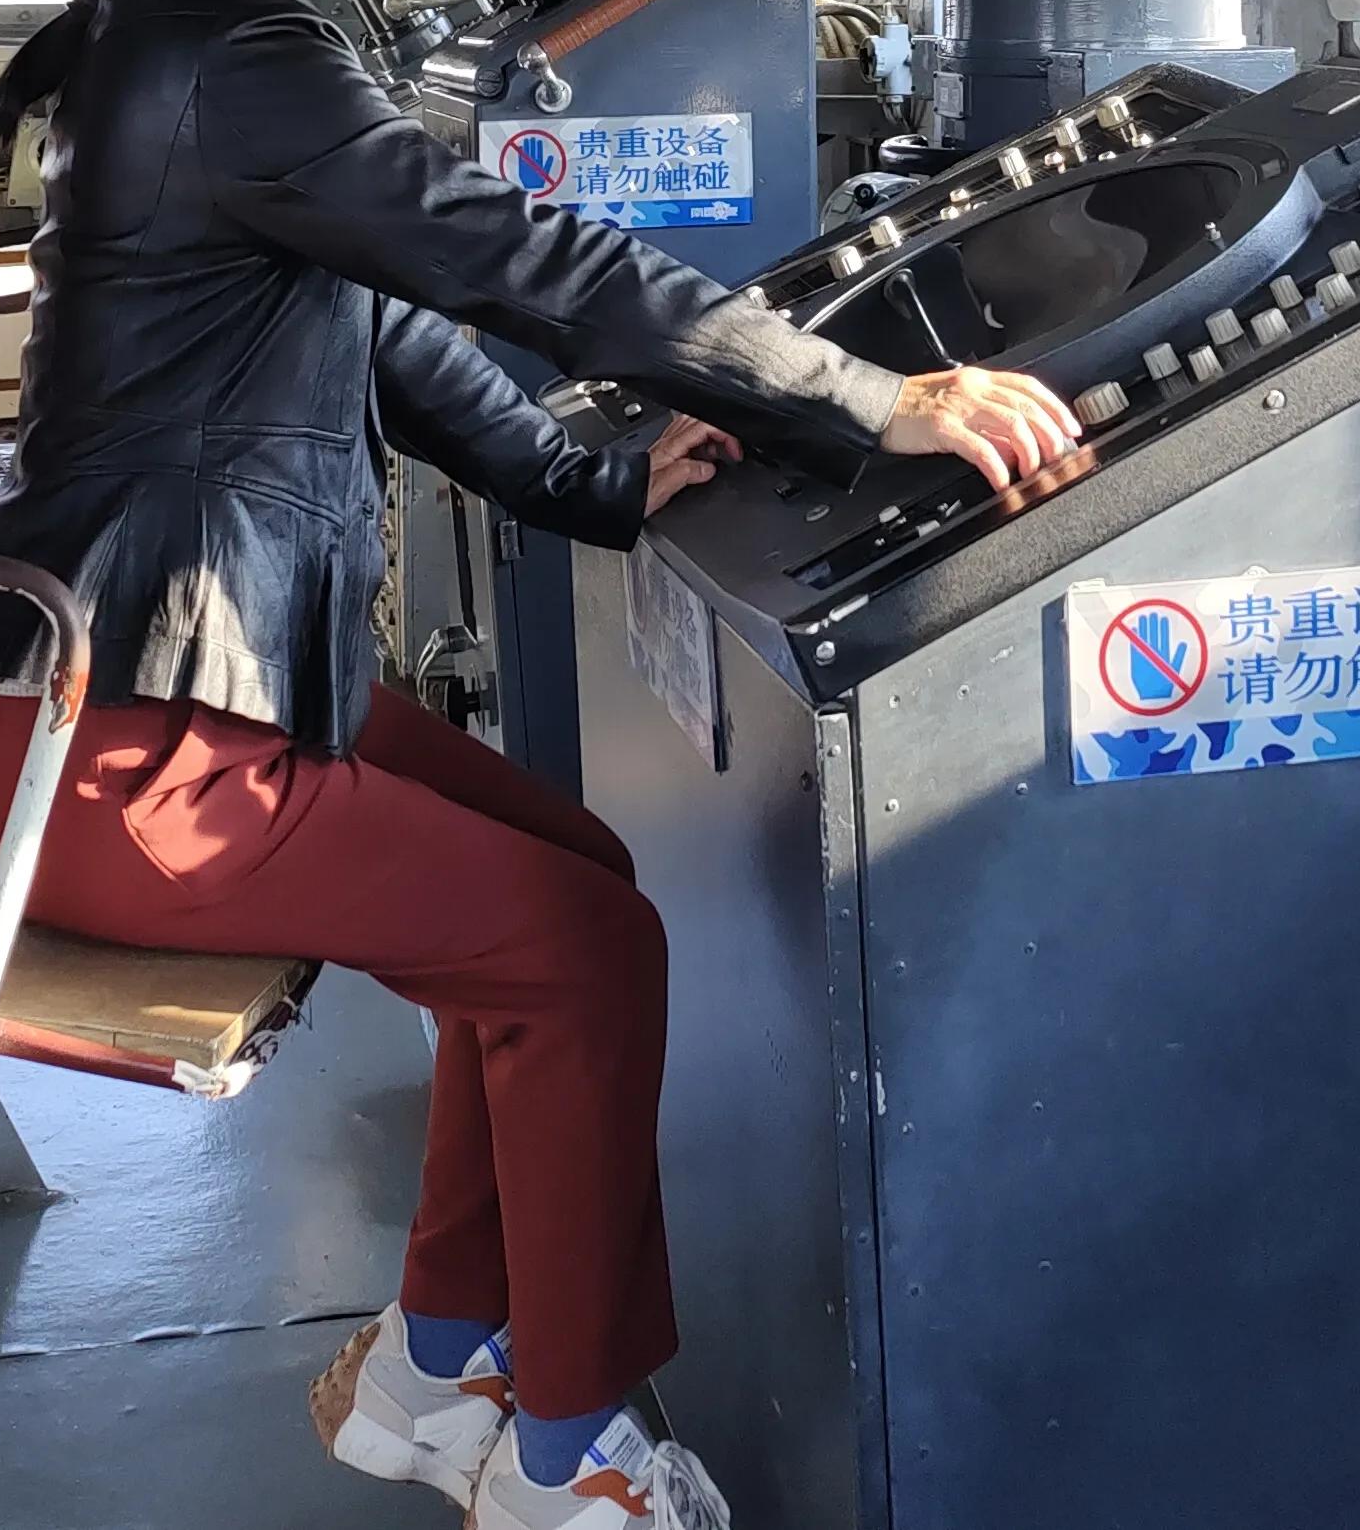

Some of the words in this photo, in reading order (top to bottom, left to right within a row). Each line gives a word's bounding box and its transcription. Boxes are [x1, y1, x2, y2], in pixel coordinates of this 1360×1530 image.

[573, 125, 730, 160] 贵重设备
[572, 160, 731, 195] 请勿触碰
